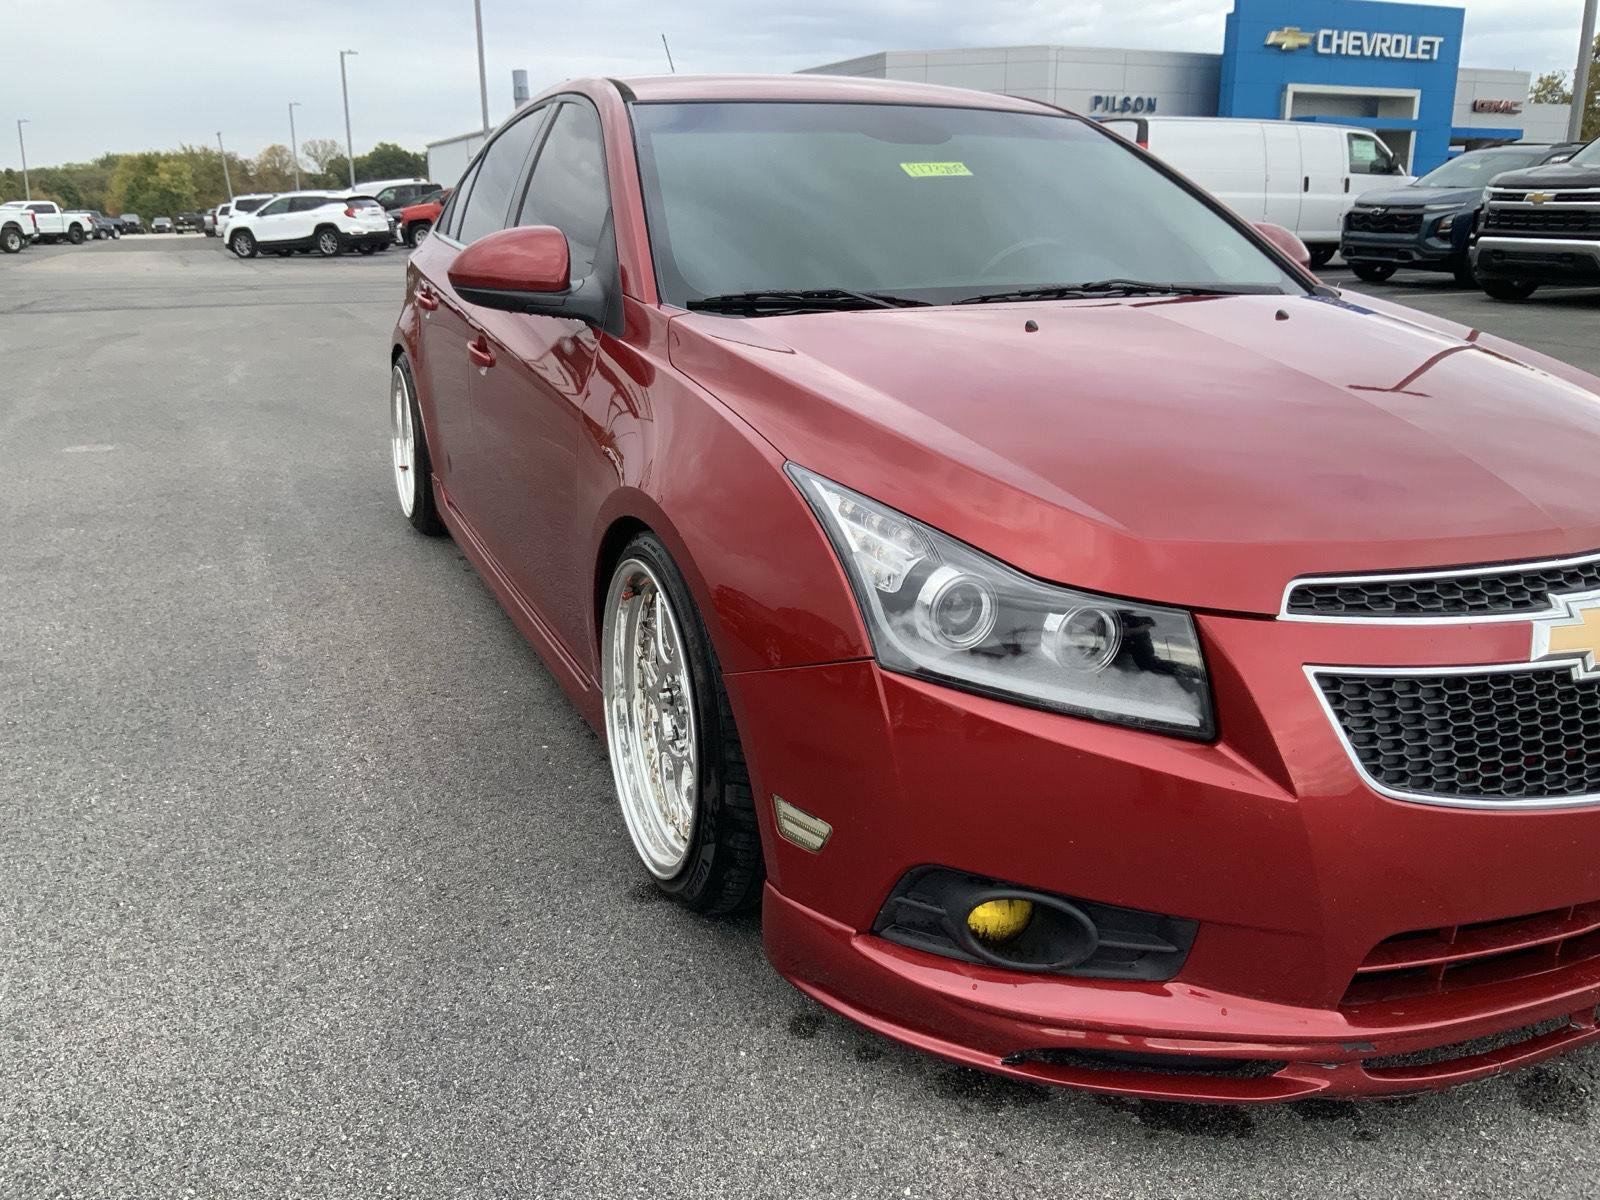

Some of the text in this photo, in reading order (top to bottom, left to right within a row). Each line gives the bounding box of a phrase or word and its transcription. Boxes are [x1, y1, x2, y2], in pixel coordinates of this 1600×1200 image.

[1317, 28, 1444, 60] CHEVROLET
[1091, 95, 1157, 113] PILSON
[1473, 99, 1522, 114] GMC
